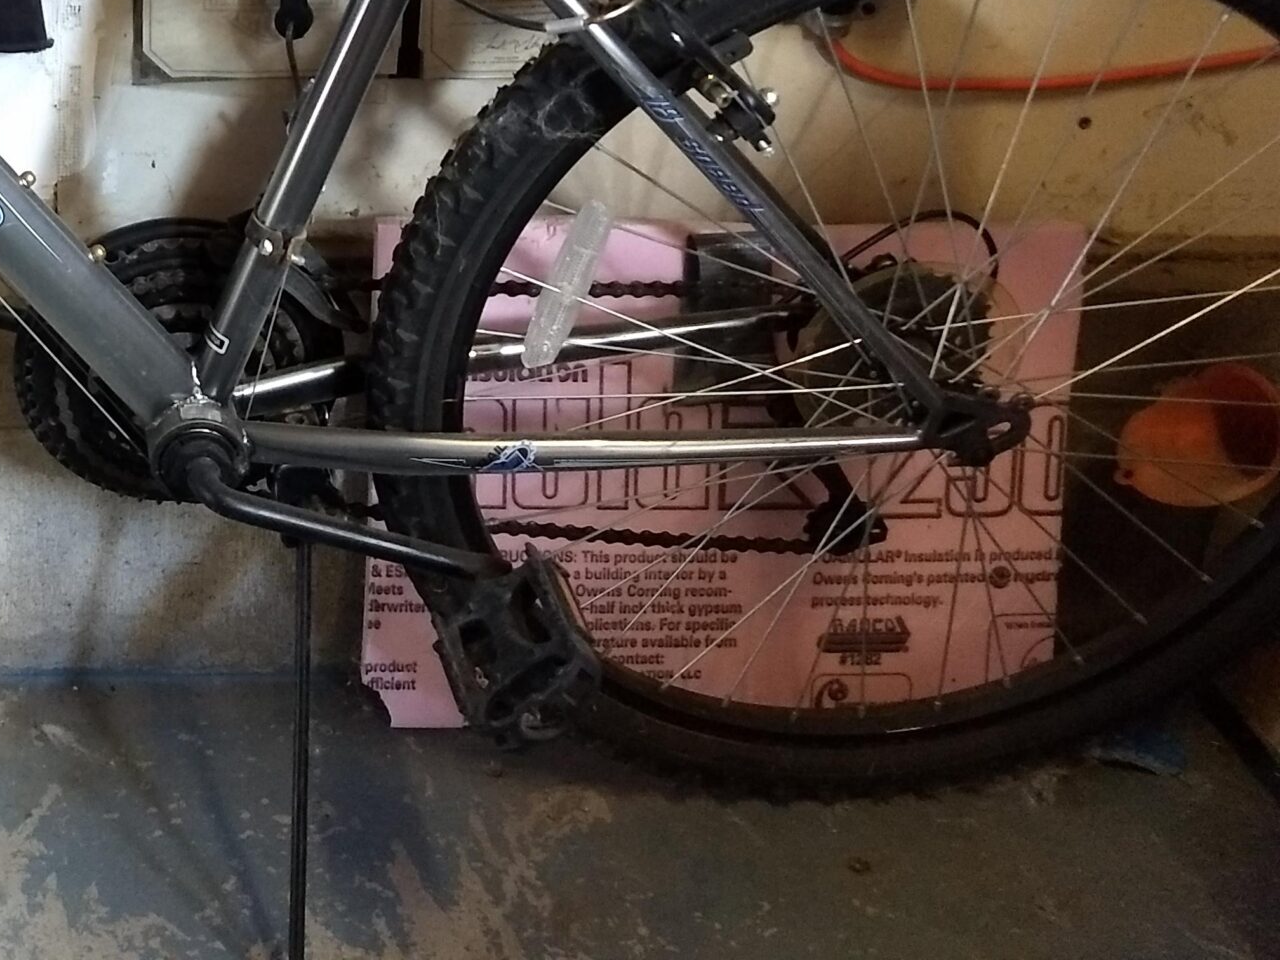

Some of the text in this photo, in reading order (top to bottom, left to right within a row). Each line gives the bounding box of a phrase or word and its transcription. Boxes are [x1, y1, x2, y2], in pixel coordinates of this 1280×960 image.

[582, 550, 611, 564] This
[613, 551, 668, 566] product
[671, 551, 717, 564] should
[720, 551, 738, 564] be
[904, 549, 970, 563] Insulation
[989, 549, 1053, 566] produced
[371, 564, 408, 578] & ES
[573, 568, 727, 583] a building inteior by a
[813, 572, 858, 586] Owens
[926, 571, 986, 588] patented
[575, 584, 732, 599] Owens Corning recom-
[619, 601, 647, 615] inch
[651, 601, 685, 615] thick
[688, 604, 743, 617] gypsum
[811, 595, 862, 608] process
[659, 618, 681, 631] For
[684, 618, 737, 632] specific
[641, 636, 701, 649] available
[704, 636, 738, 649] from
[613, 652, 665, 665] contact:
[365, 659, 418, 675] product
